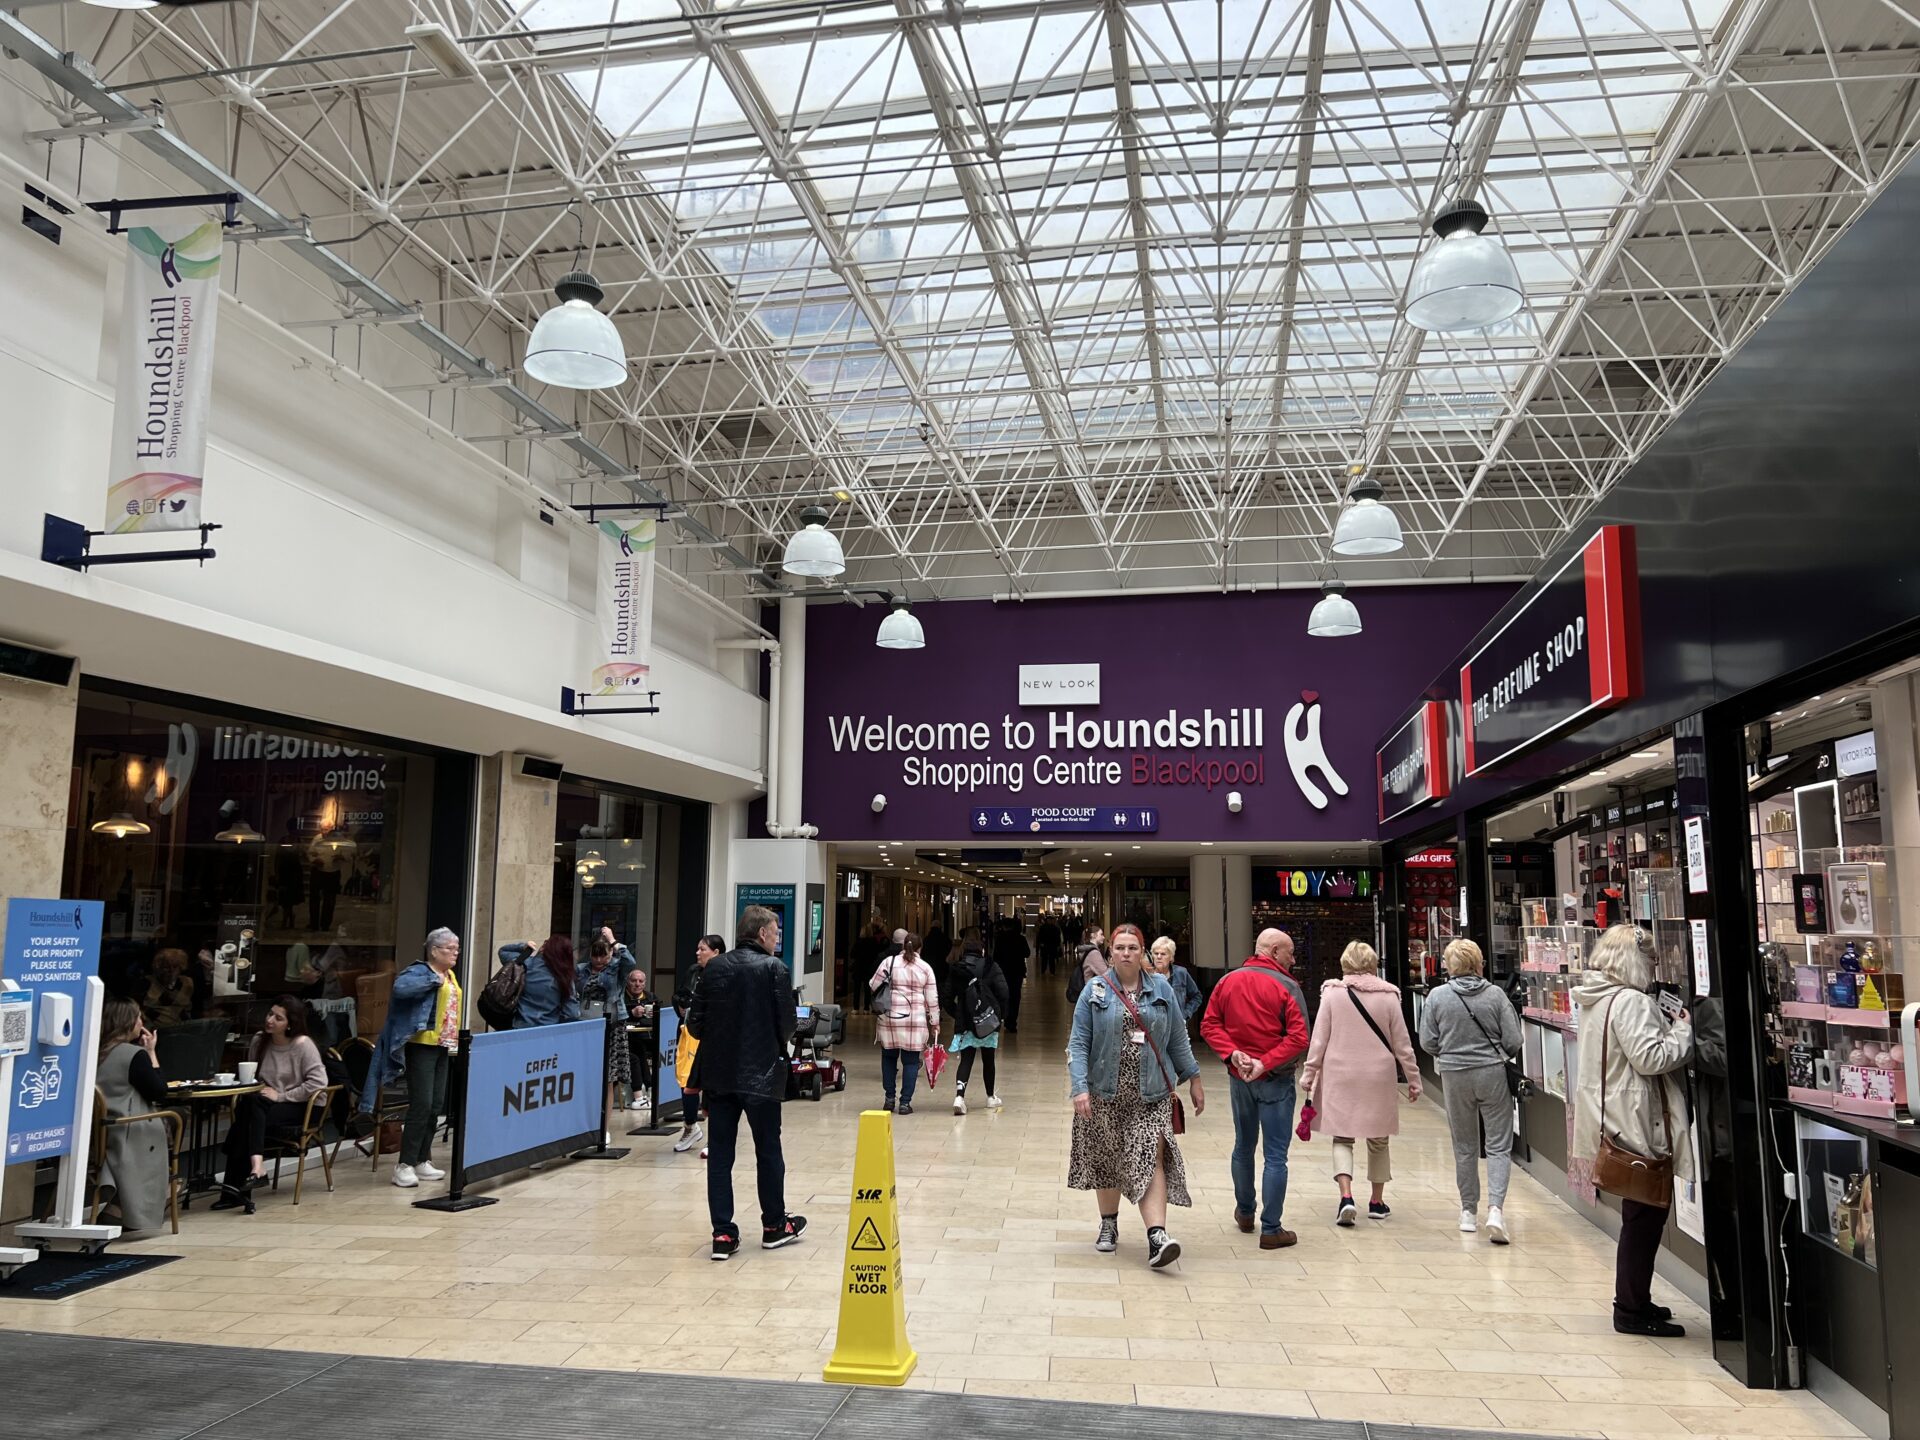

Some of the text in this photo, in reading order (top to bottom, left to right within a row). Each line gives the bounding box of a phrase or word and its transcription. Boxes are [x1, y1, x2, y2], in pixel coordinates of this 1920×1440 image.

[137, 295, 176, 460] Houndshill
[167, 296, 193, 458] Shopping Centre Blackpool
[631, 561, 640, 595] Blackpool
[611, 561, 631, 655] Houndshill
[629, 621, 639, 654] Shopping
[1473, 616, 1584, 727] THE PERFUME SHOP
[1023, 679, 1095, 689] NEW LOOK
[828, 708, 1263, 752] Welcome to Houndshill
[903, 753, 1264, 792] Shopping Centre Blackpool
[1031, 807, 1097, 817] FOOD COURT
[1429, 854, 1452, 863] GIFTS
[1276, 870, 1326, 896] TOY
[749, 887, 793, 897] eurochange
[30, 911, 73, 922] Houndshill
[30, 937, 80, 946] YOUR SAFETY
[23, 949, 84, 958] IS OUR PRIORITY
[30, 961, 73, 970] PLEASE USE
[20, 972, 81, 982] HAND SANITISER
[526, 1054, 558, 1074] CAFFÈ
[503, 1072, 574, 1117] NERO
[26, 1127, 66, 1142] FACE MASKS
[28, 1140, 62, 1152] REQUIRED
[855, 1189, 882, 1200] SIR
[850, 1264, 887, 1272] CAUTION
[855, 1272, 881, 1282] WET
[848, 1283, 887, 1294] FLOOR
